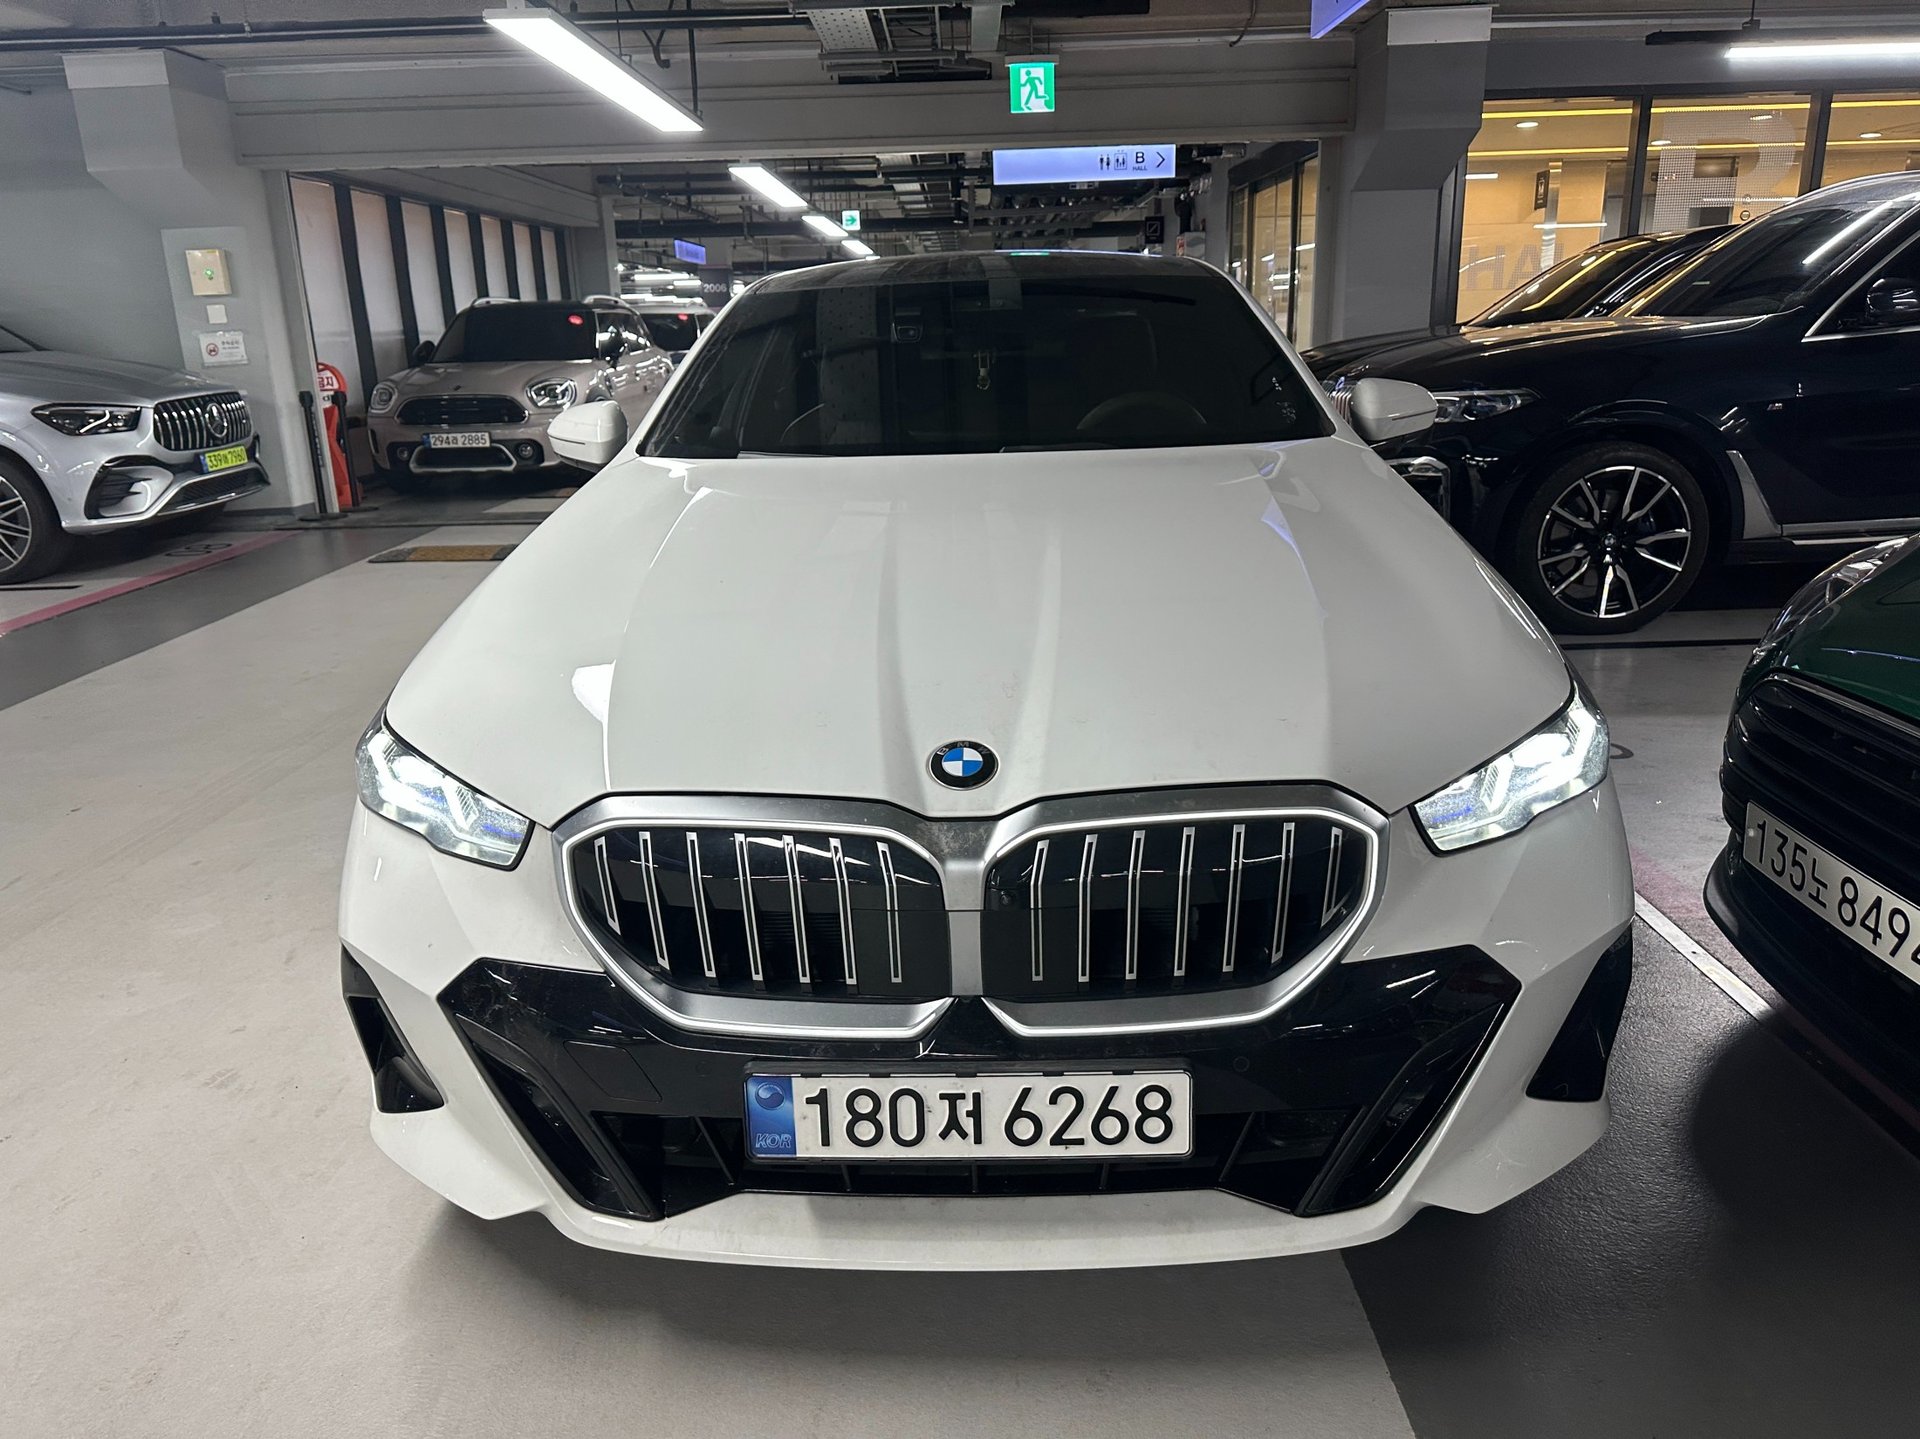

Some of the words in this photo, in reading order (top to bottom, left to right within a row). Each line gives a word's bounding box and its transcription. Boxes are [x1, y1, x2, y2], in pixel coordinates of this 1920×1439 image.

[1135, 151, 1145, 164] B
[1465, 243, 1565, 290] HA
[703, 283, 727, 293] 2006
[460, 433, 487, 446] 2885
[936, 741, 991, 756] BMW
[1757, 819, 1828, 909] 135노
[805, 1086, 982, 1148] 180저
[1004, 1084, 1173, 1146] 6268
[755, 1133, 792, 1148] KOR
